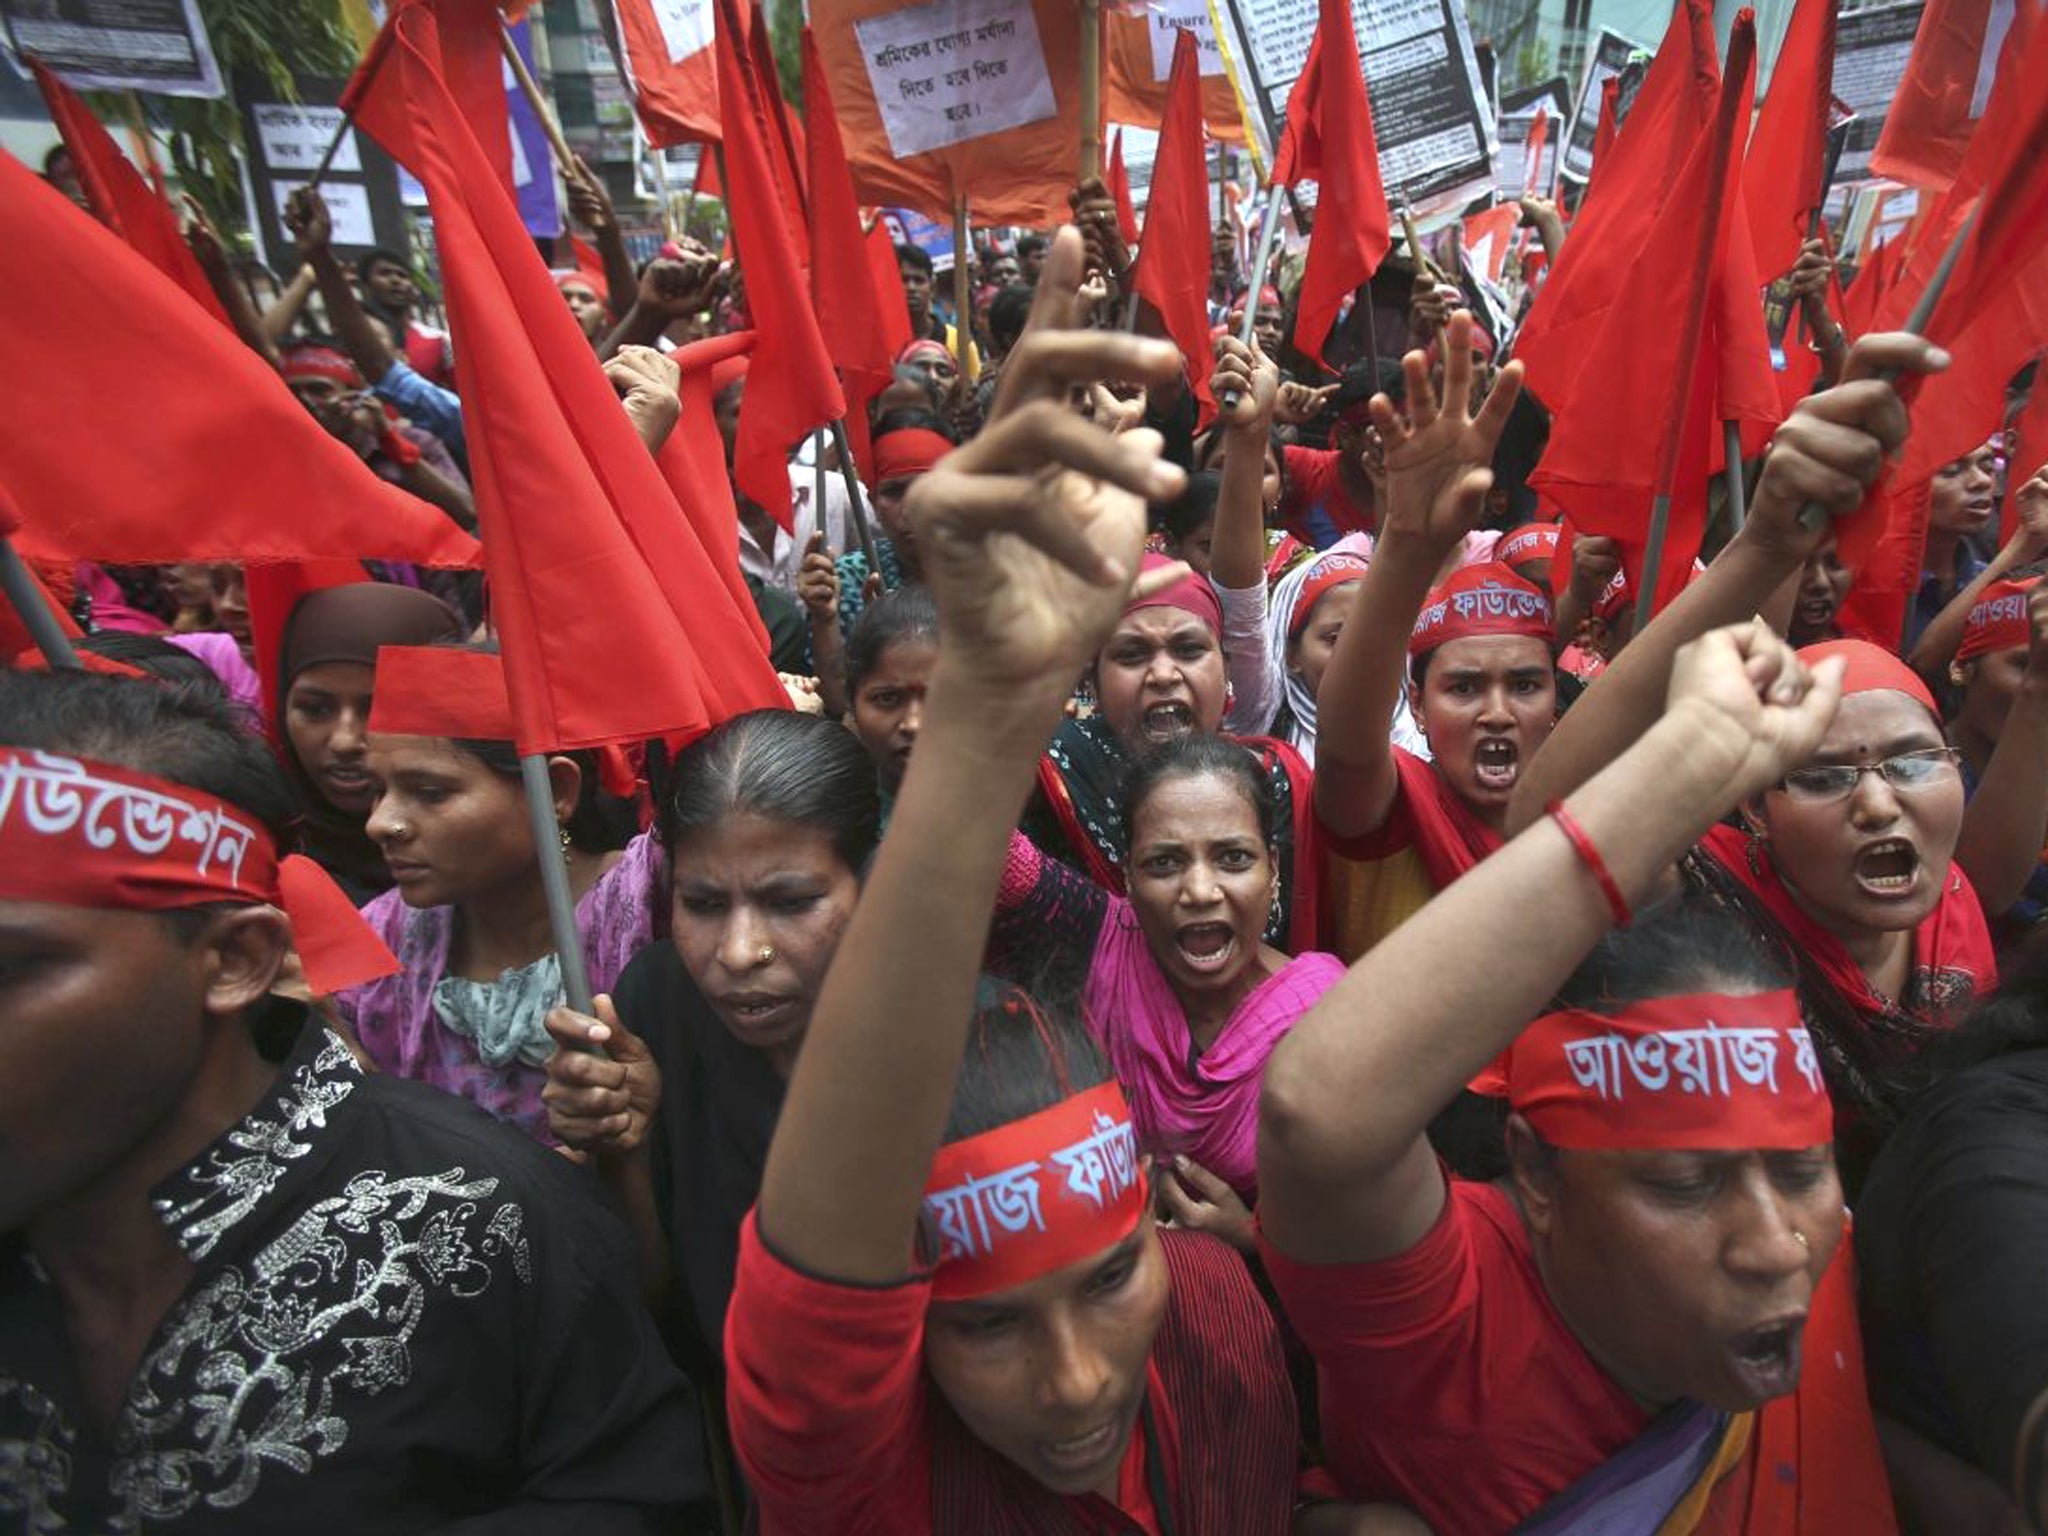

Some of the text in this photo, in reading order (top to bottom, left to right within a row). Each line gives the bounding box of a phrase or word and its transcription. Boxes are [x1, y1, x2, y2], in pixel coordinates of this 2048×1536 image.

[874, 41, 931, 69] শ্রমিকের
[933, 30, 972, 54] যোগ্য
[899, 58, 1008, 101] দিতে হবে দিতে
[1968, 594, 2027, 627] আওয়া
[0, 750, 256, 888] াউন্ডেশন
[1563, 1020, 1780, 1099] আওয়াজ
[926, 1161, 1046, 1260] য়াজ
